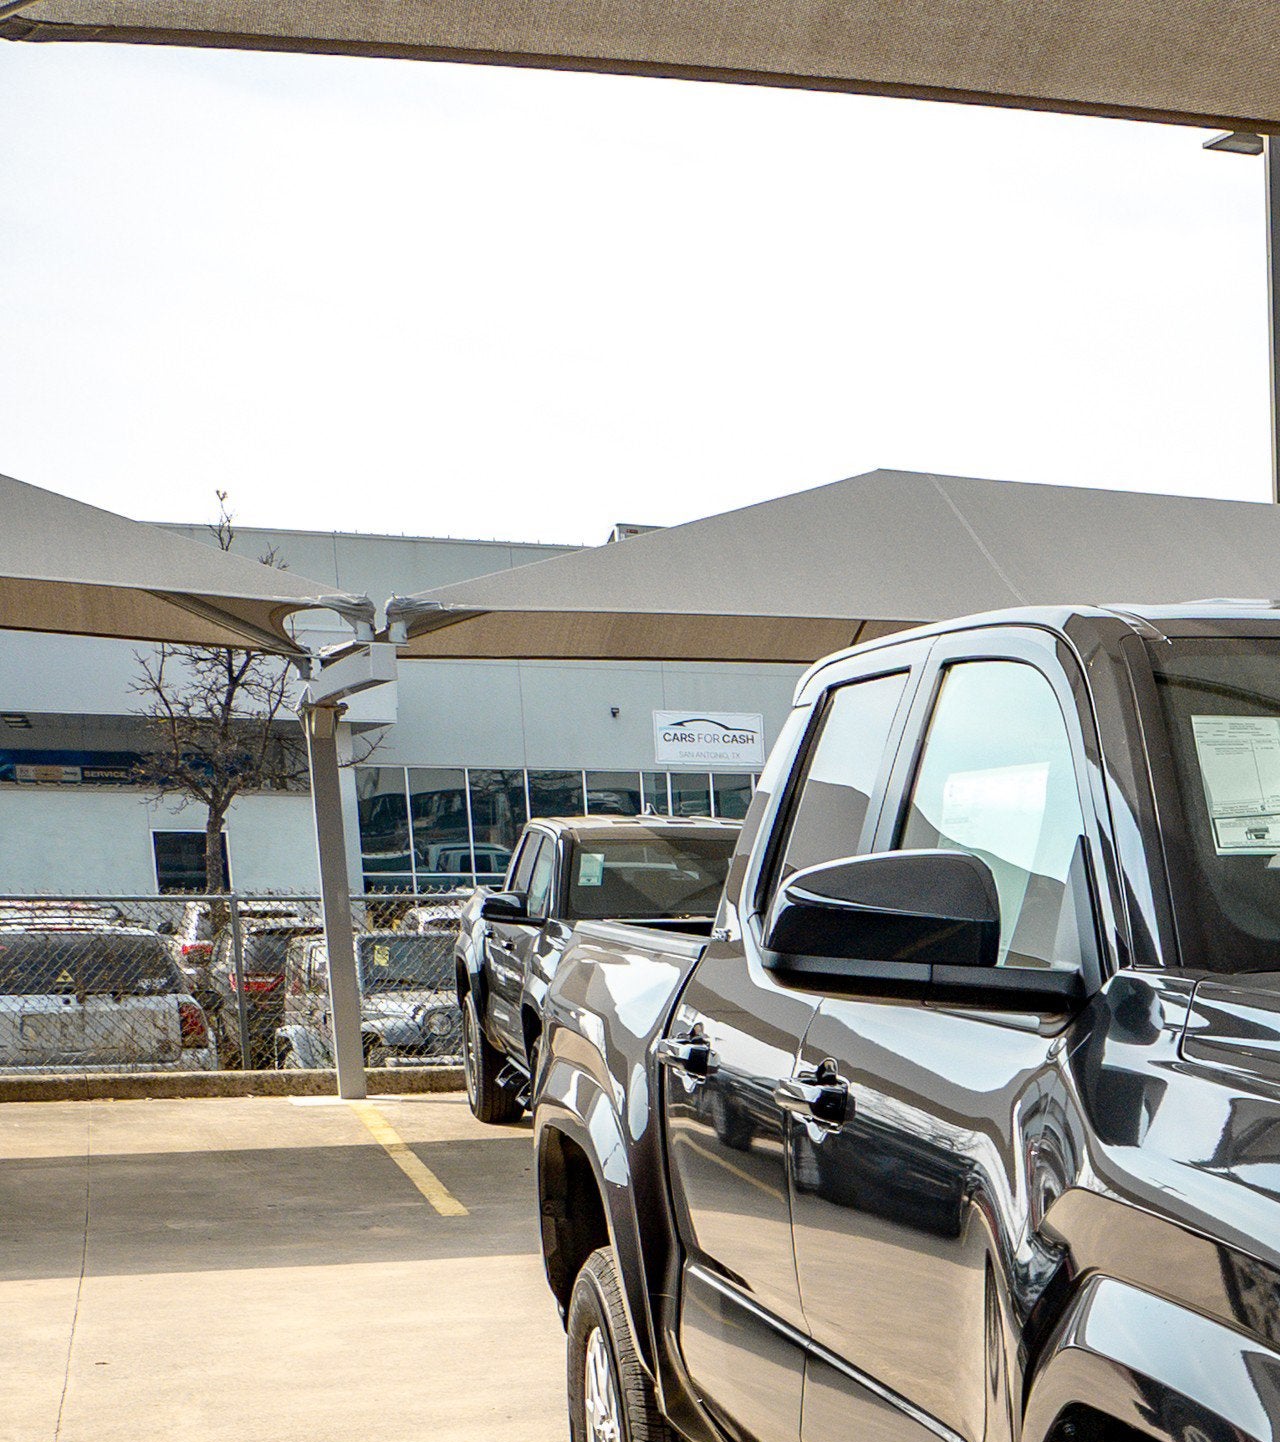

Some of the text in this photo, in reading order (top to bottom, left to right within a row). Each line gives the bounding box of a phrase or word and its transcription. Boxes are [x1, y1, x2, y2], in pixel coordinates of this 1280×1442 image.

[663, 732, 755, 744] CARS FOR CASH
